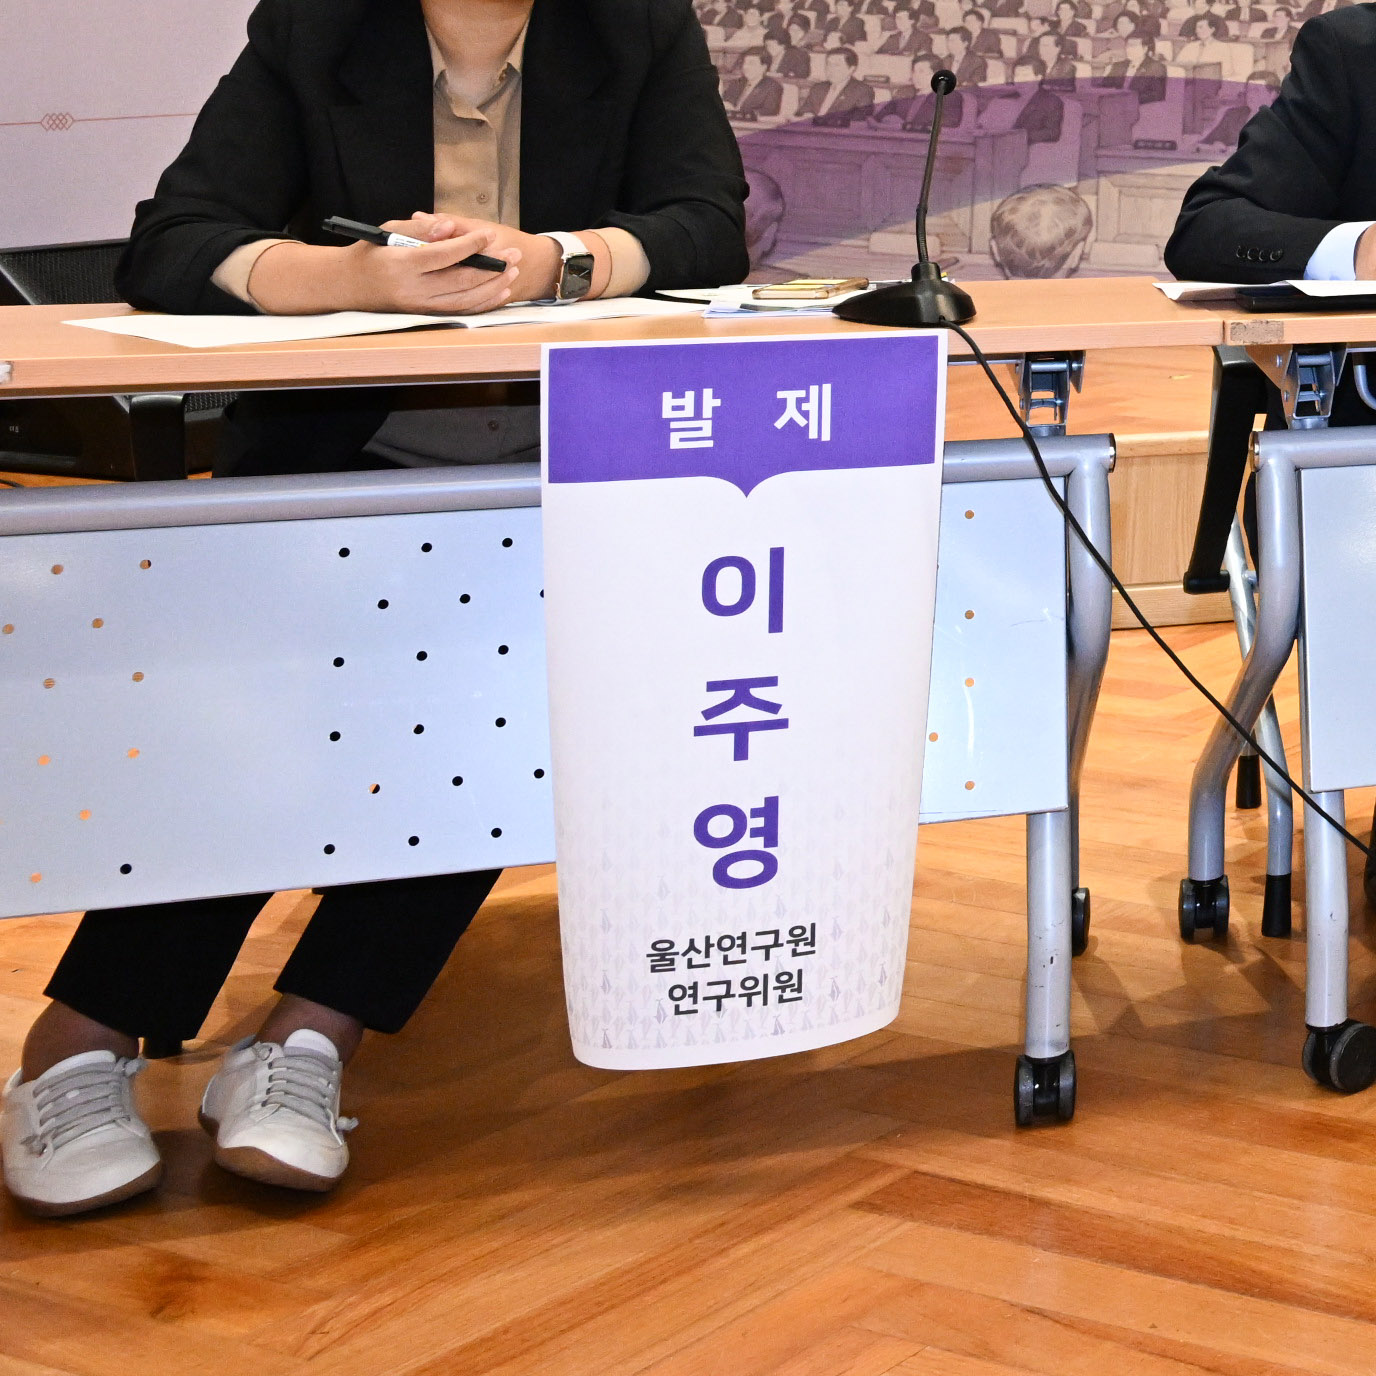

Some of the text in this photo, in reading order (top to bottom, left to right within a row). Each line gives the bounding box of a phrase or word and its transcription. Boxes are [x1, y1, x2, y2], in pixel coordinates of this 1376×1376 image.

[693, 547, 790, 889] 이주영
[645, 923, 817, 974] 울산연구원
[667, 968, 803, 1017] 연구위원
